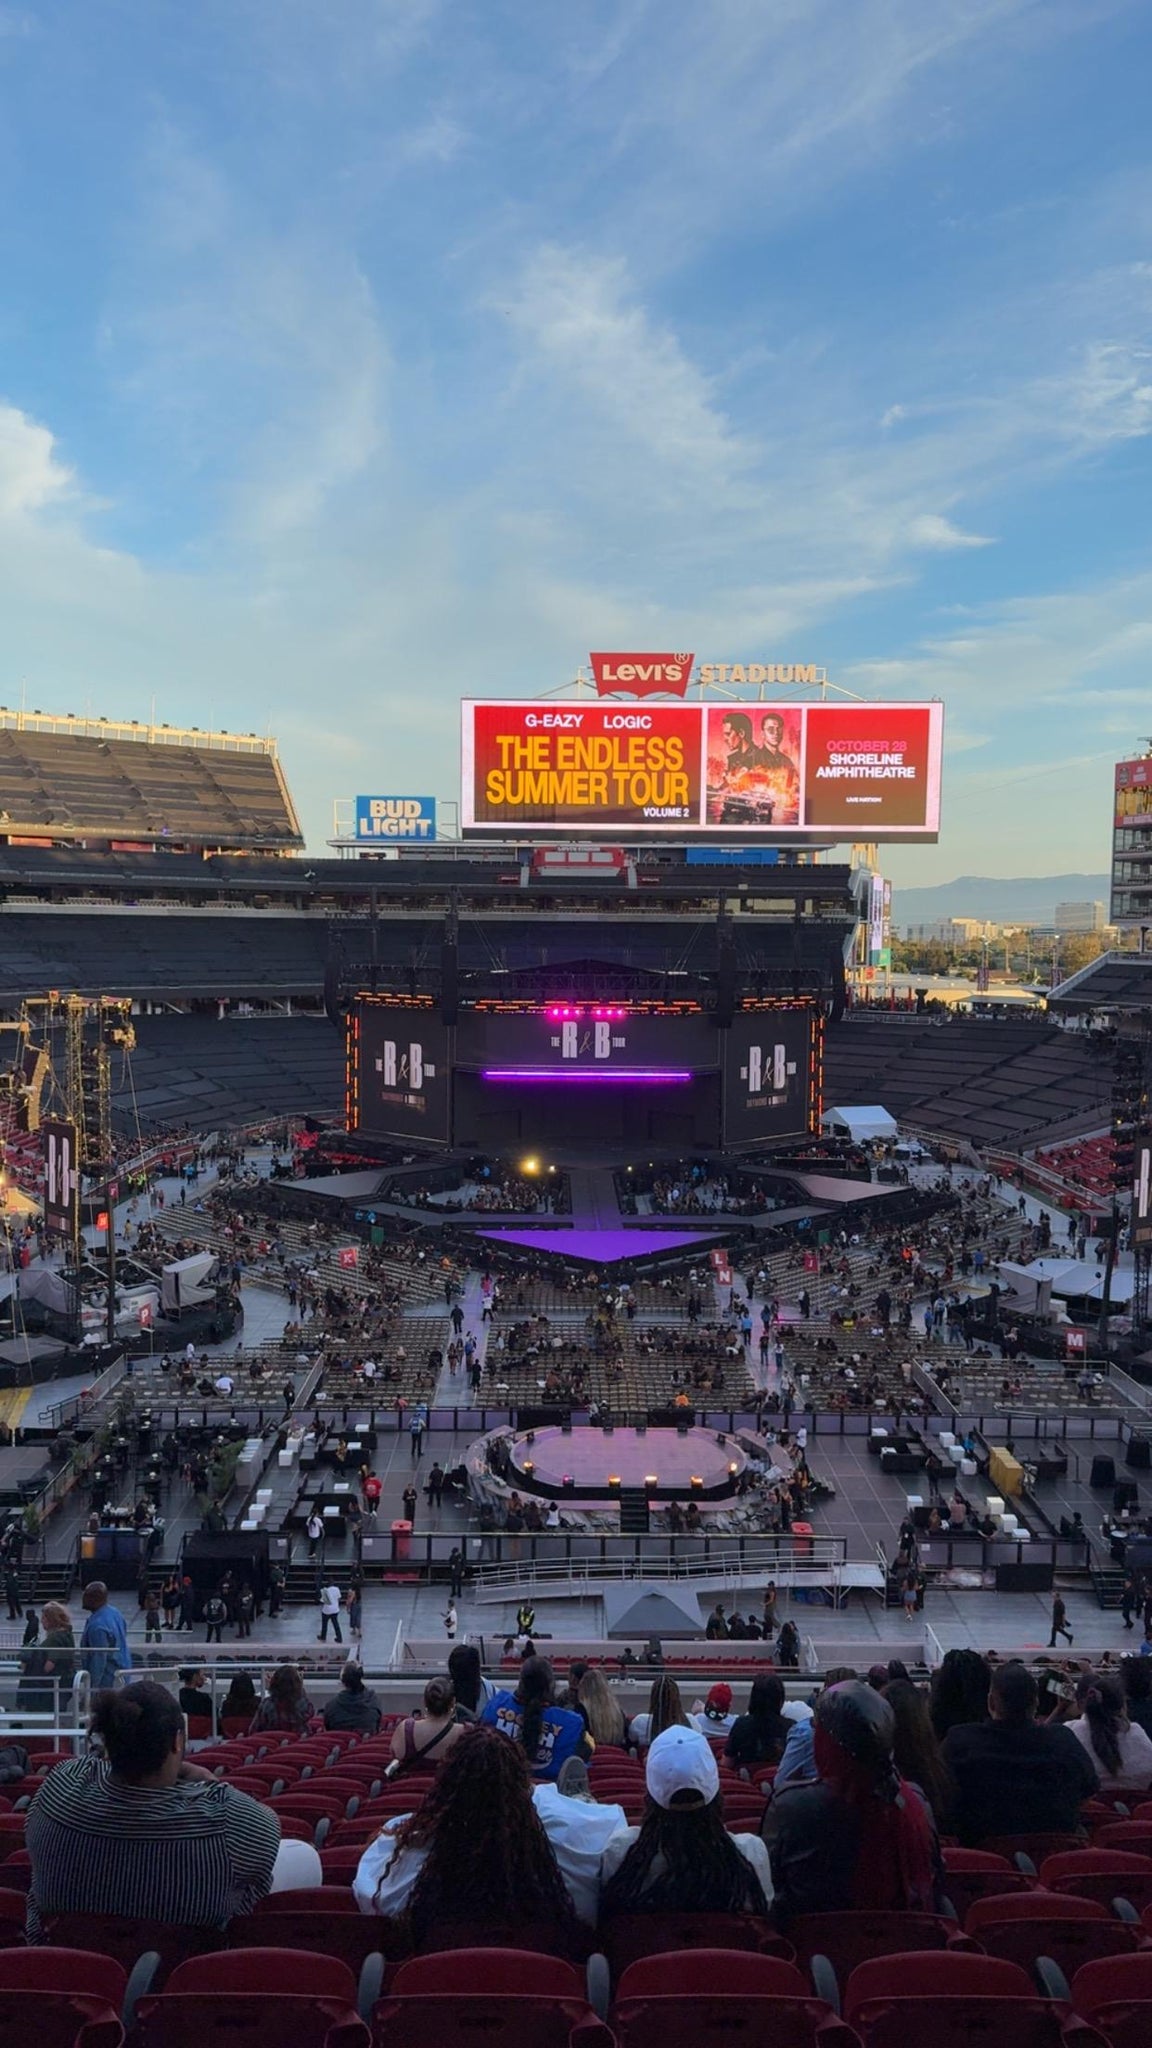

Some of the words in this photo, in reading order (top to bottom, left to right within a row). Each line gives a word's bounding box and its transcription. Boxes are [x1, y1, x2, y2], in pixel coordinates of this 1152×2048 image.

[701, 664, 817, 683] STADIUM
[525, 714, 584, 727] G-EAZY
[603, 715, 652, 729] LOGIC
[826, 740, 890, 752] OCTOBER
[892, 740, 908, 752] 28
[496, 735, 550, 770] THE
[557, 736, 684, 771] ENDLESS
[829, 753, 904, 765] SHORELINE
[816, 766, 916, 778] AMPHITHEATRE
[486, 769, 609, 805] SUMMER
[613, 771, 689, 806] TOUR
[369, 799, 421, 818] BUD
[643, 807, 682, 817] VOLUME
[683, 807, 690, 817] 2
[360, 818, 432, 836] LIGHT
[715, 1253, 723, 1264] L
[720, 1270, 730, 1282] N
[142, 1309, 149, 1322] P
[1067, 1333, 1083, 1346] M
